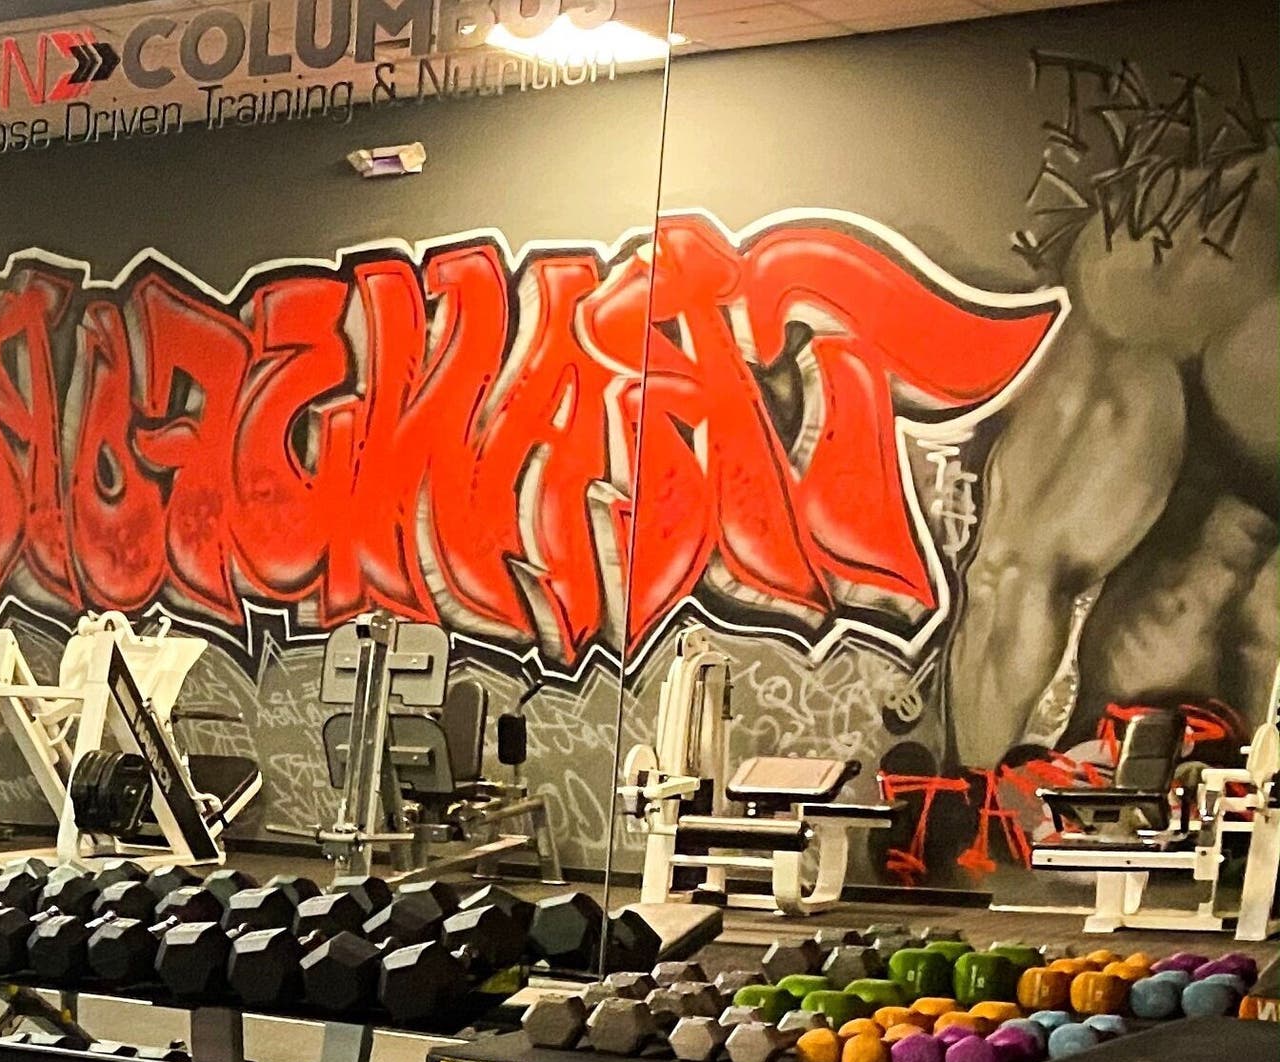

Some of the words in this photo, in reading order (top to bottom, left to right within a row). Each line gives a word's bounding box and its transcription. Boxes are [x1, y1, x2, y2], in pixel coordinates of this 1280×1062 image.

[64, 96, 183, 147] Driven
[199, 77, 354, 132] Training
[373, 62, 397, 100] &
[418, 50, 617, 101] Nutrition
